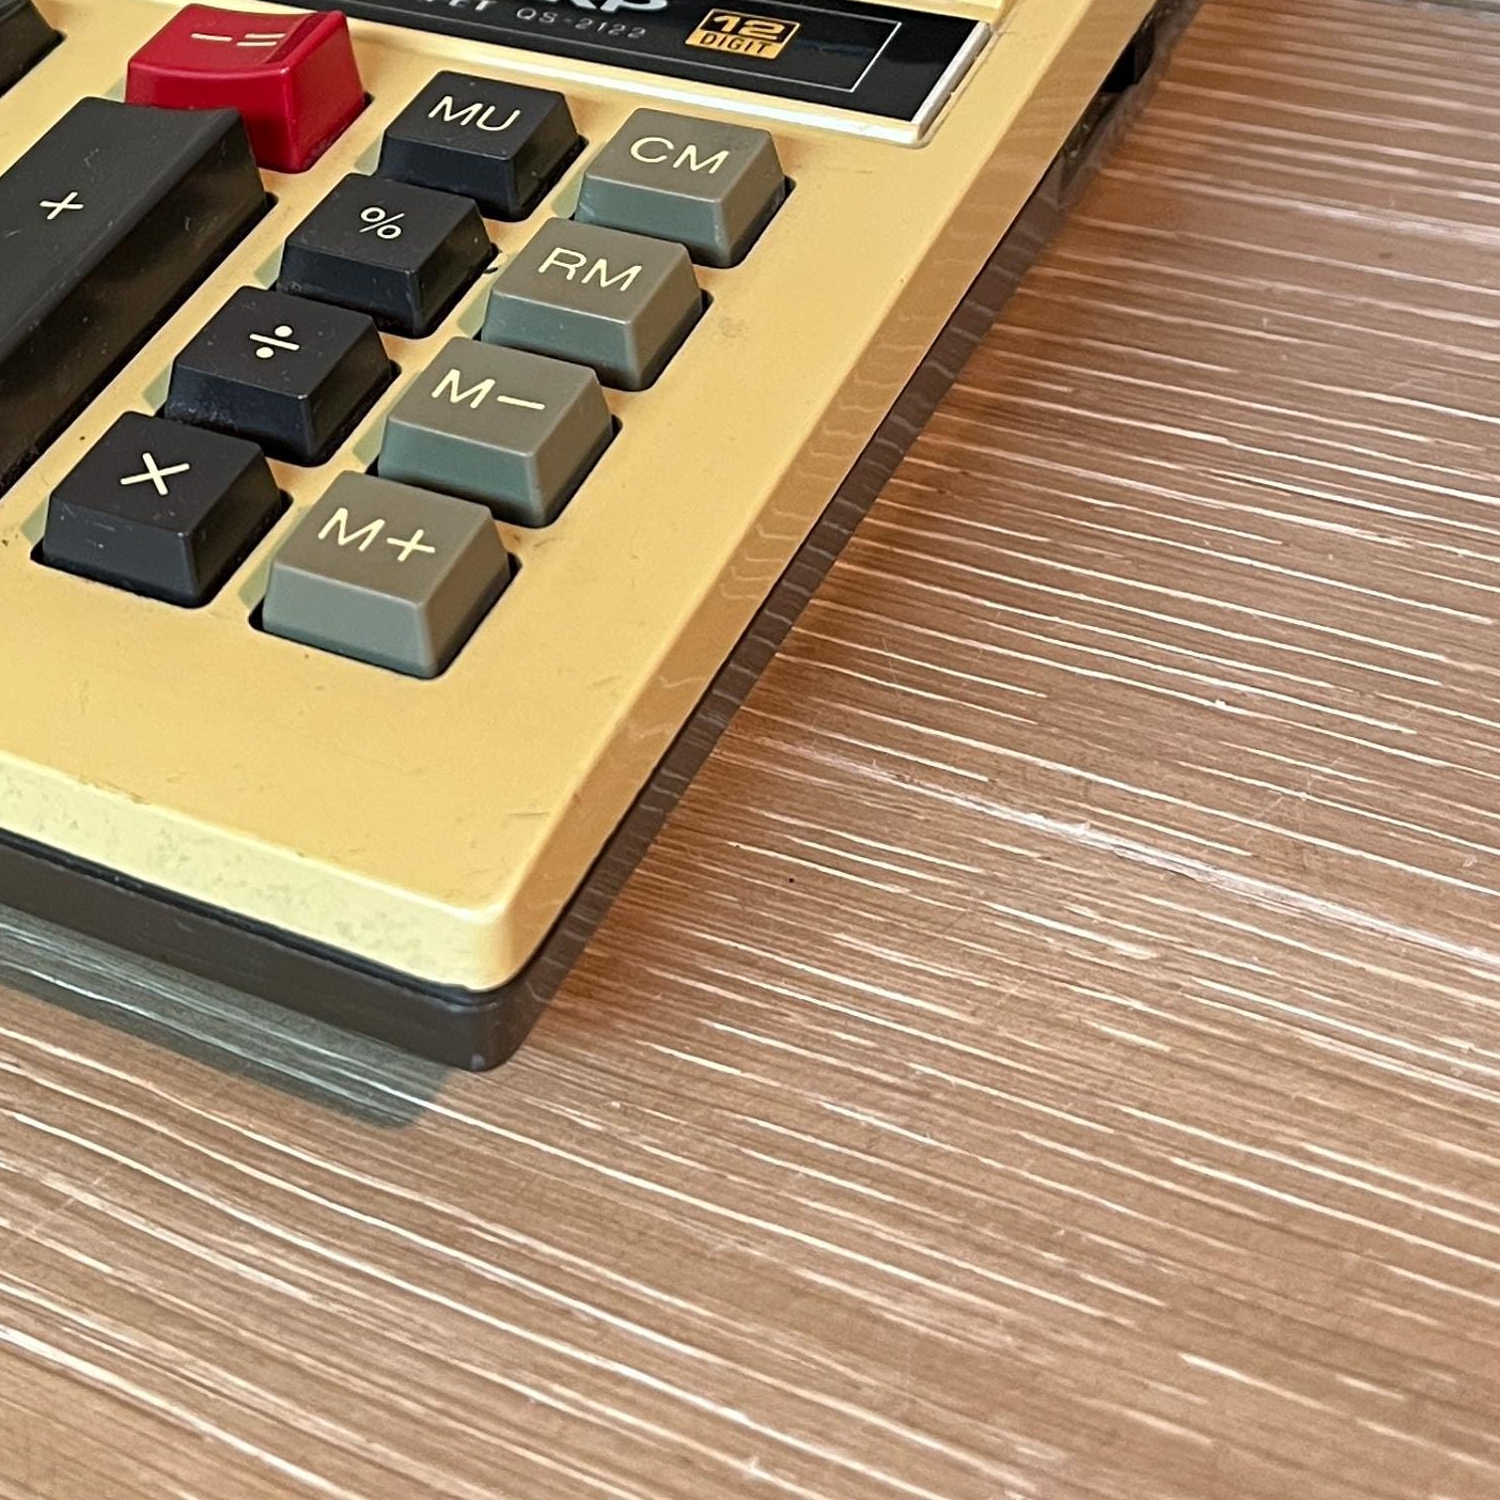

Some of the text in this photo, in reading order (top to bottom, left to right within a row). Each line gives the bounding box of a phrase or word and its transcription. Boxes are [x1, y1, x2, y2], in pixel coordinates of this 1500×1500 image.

[700, 32, 773, 55] DIGIT
[713, 15, 786, 41] 12
[428, 95, 521, 131] MU
[630, 136, 730, 174] CM
[359, 206, 405, 239] %
[538, 247, 642, 292] RM
[317, 507, 436, 562] M+
